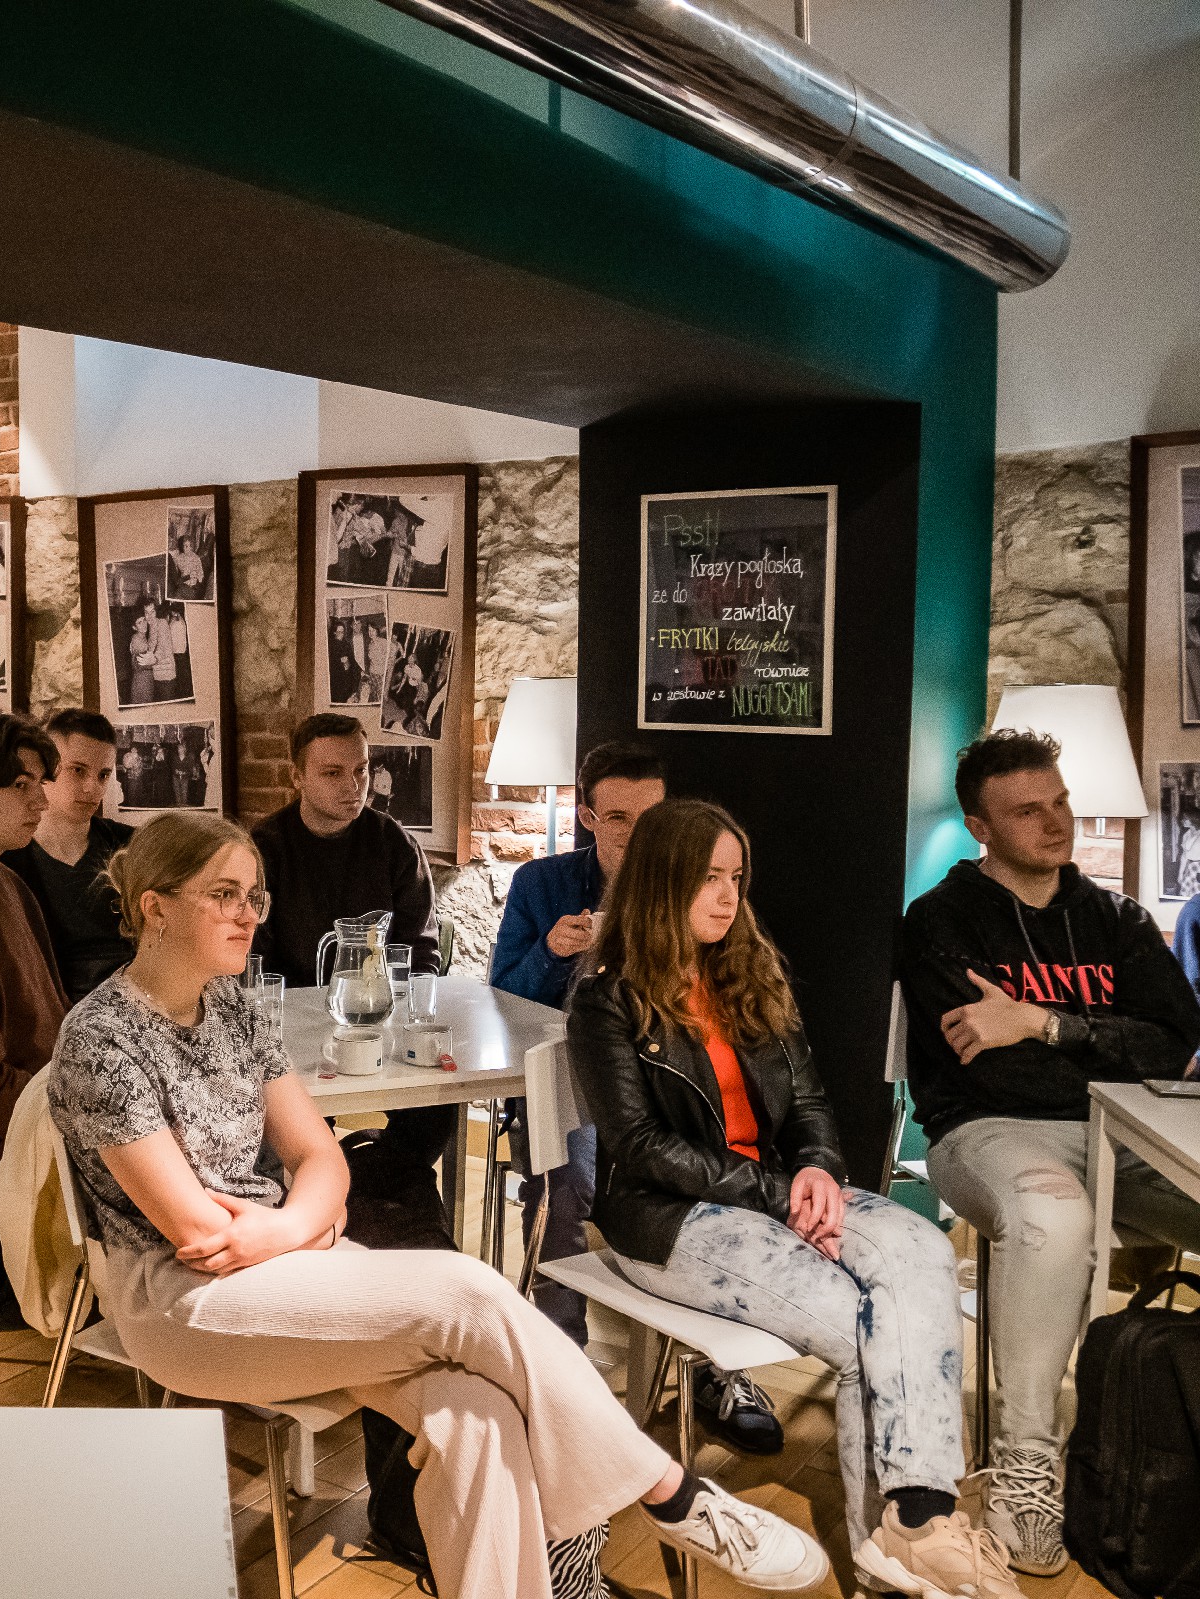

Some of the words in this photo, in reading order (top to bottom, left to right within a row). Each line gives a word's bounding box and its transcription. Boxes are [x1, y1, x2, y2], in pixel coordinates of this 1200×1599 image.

[663, 509, 720, 547] Psst!
[673, 581, 688, 604] do
[657, 626, 720, 650] FRYTKI
[731, 681, 814, 718] NUGGETSAMI
[997, 961, 1115, 1006] SAINTS
